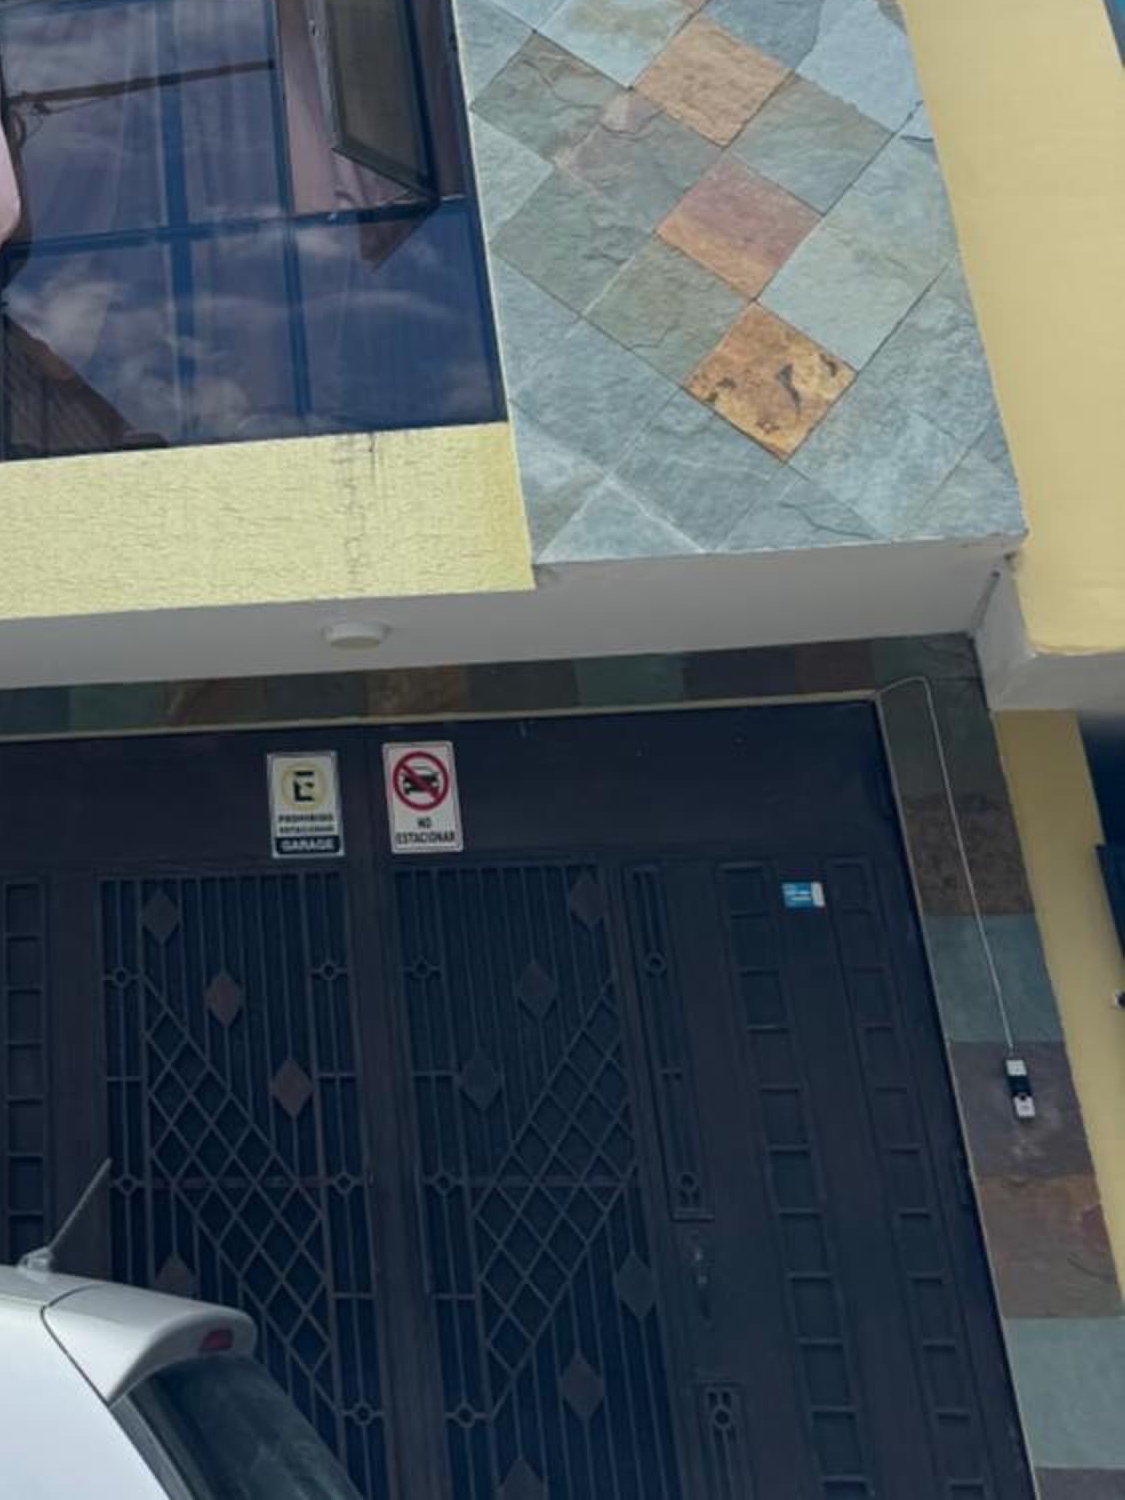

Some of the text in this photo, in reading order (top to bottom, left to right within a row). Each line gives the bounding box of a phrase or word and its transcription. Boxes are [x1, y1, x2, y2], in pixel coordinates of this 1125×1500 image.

[294, 771, 315, 802] E
[416, 817, 432, 829] NO
[396, 831, 455, 844] ESTACIONAR
[281, 839, 334, 850] GARAGE
